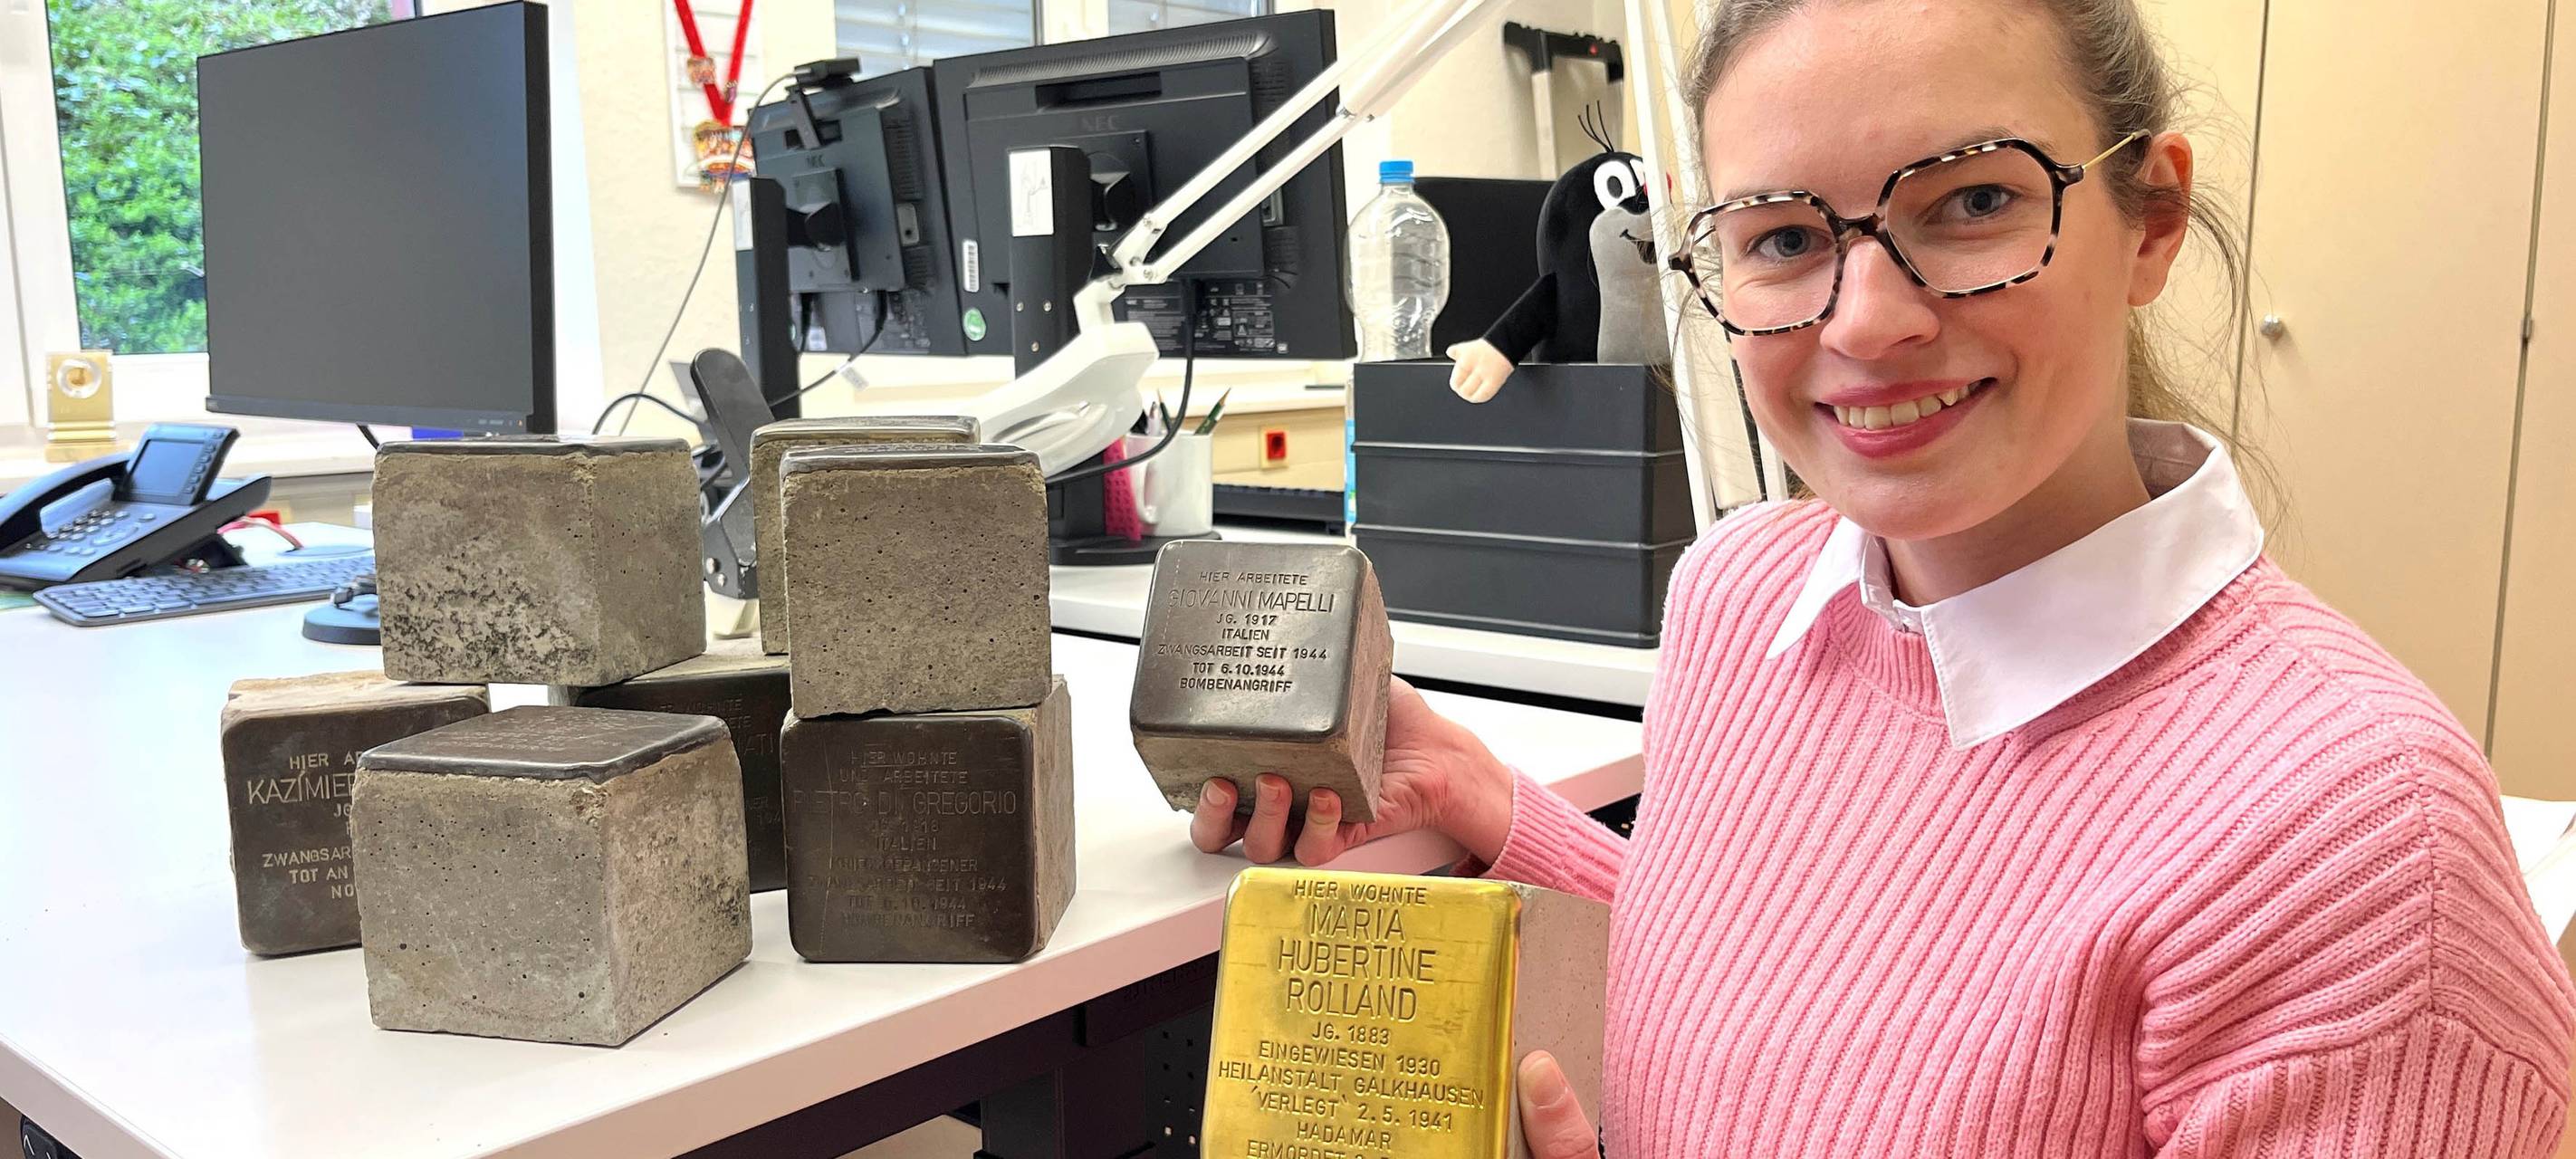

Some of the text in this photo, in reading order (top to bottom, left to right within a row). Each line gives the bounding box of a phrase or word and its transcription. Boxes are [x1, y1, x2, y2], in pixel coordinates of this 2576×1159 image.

[1199, 571, 1309, 586] HIER ARBEITETE
[1168, 589, 1335, 613] GIOVANNI MAPELLI
[1216, 614, 1278, 626] JG. 1917
[1221, 628, 1270, 641] ITALIEN
[1157, 644, 1328, 660] ZWANGSARBEIT SEIT 1944
[1192, 662, 1286, 677] TOT 6.10.1944
[1179, 677, 1294, 693] BOMBENANGRIFF
[290, 753, 329, 770] HIER
[850, 751, 958, 766] HIER WOHNTE
[883, 770, 969, 785] ARBEITETE
[792, 790, 869, 815] PIETRO
[913, 790, 1017, 815] GREGORIO
[876, 836, 937, 852] ITALIEN
[289, 865, 349, 885] TOT AN
[970, 876, 1008, 892] 1944
[1294, 879, 1427, 905] HIER WOHNTE
[1310, 903, 1406, 943] MARIA
[1277, 939, 1437, 984] HUBERTINE
[1286, 977, 1418, 1023] ROLLAND
[1311, 1022, 1391, 1046] JG. 1883
[1259, 1040, 1441, 1078] EINGEWIESEN 1930
[1218, 1061, 1485, 1109] HEILANSTALT GALKHAUSEN
[1296, 1121, 1393, 1152] HADAMAR
